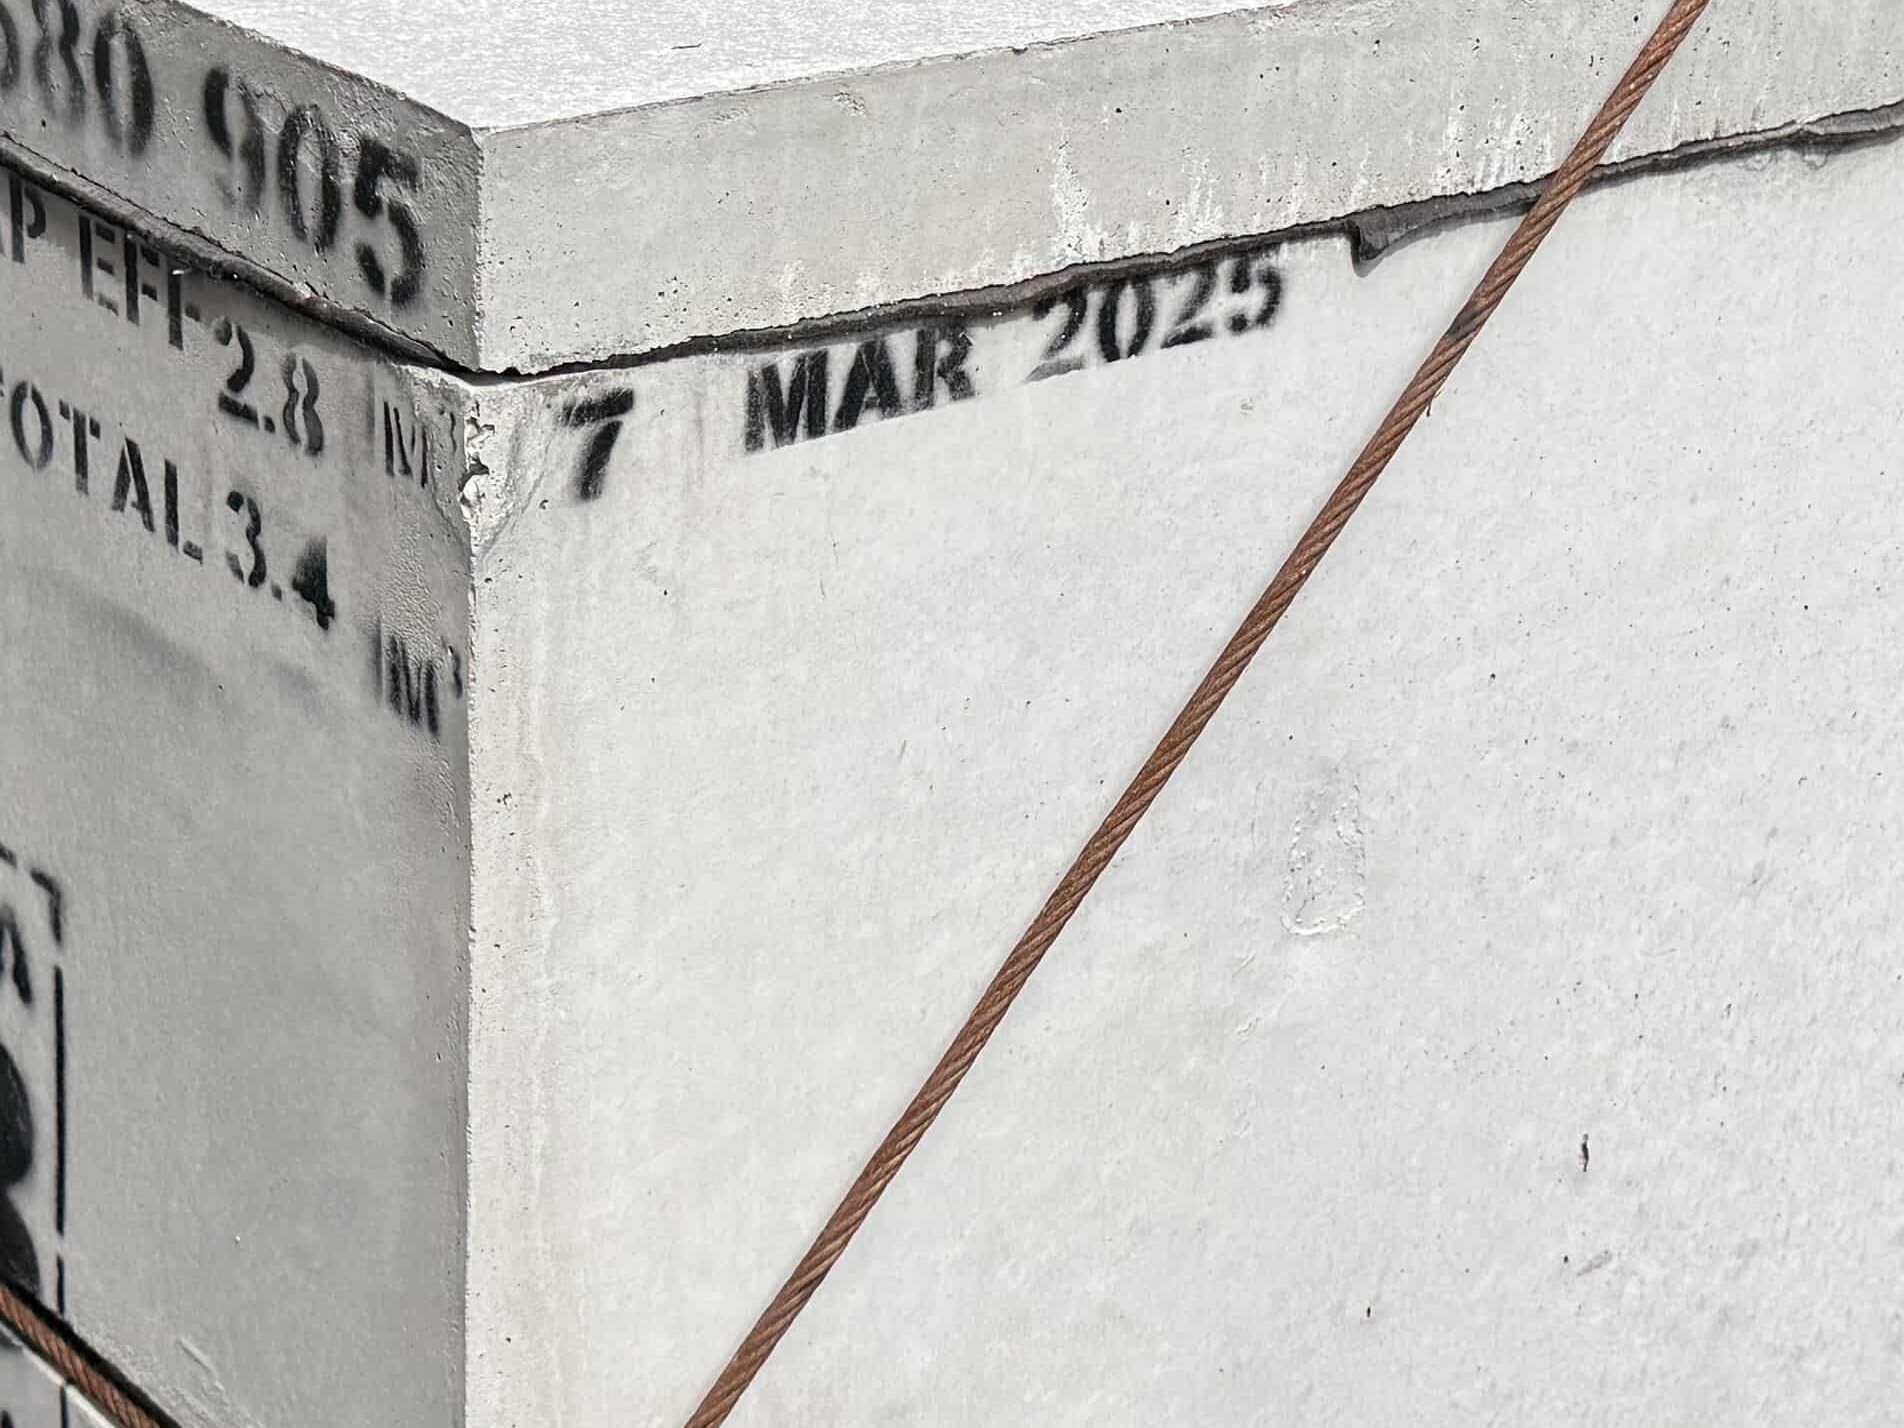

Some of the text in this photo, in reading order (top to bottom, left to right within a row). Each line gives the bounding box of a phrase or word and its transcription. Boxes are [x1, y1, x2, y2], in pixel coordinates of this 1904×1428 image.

[203, 63, 427, 310] 905
[215, 316, 324, 457] 2.8
[562, 256, 1284, 502] 7 MAR 2025
[226, 488, 336, 630] 3.4
